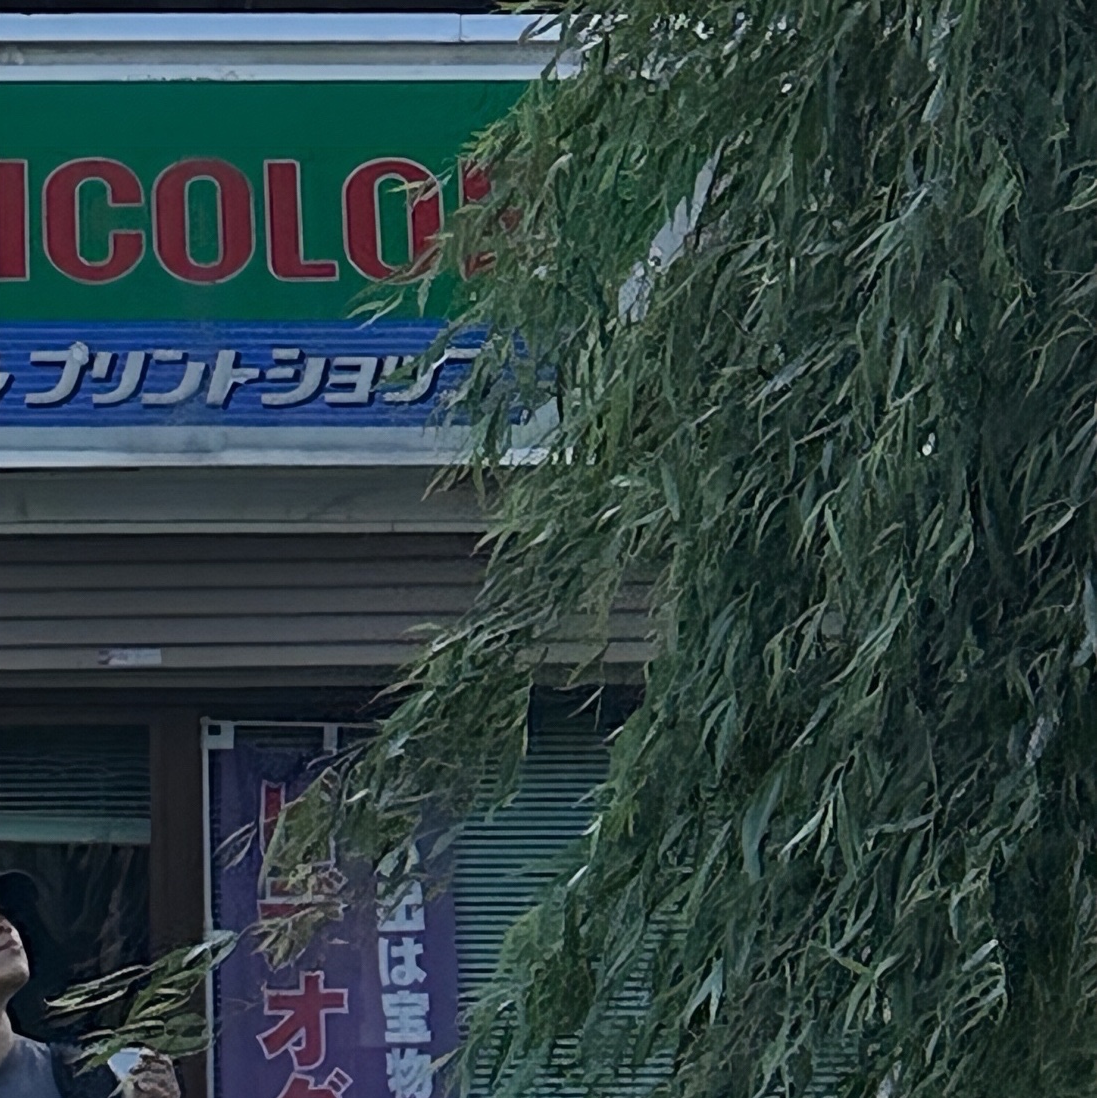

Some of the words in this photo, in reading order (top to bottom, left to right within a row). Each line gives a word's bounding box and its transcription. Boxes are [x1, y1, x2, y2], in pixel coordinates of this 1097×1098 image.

[24, 341, 482, 406] プリントショッ
